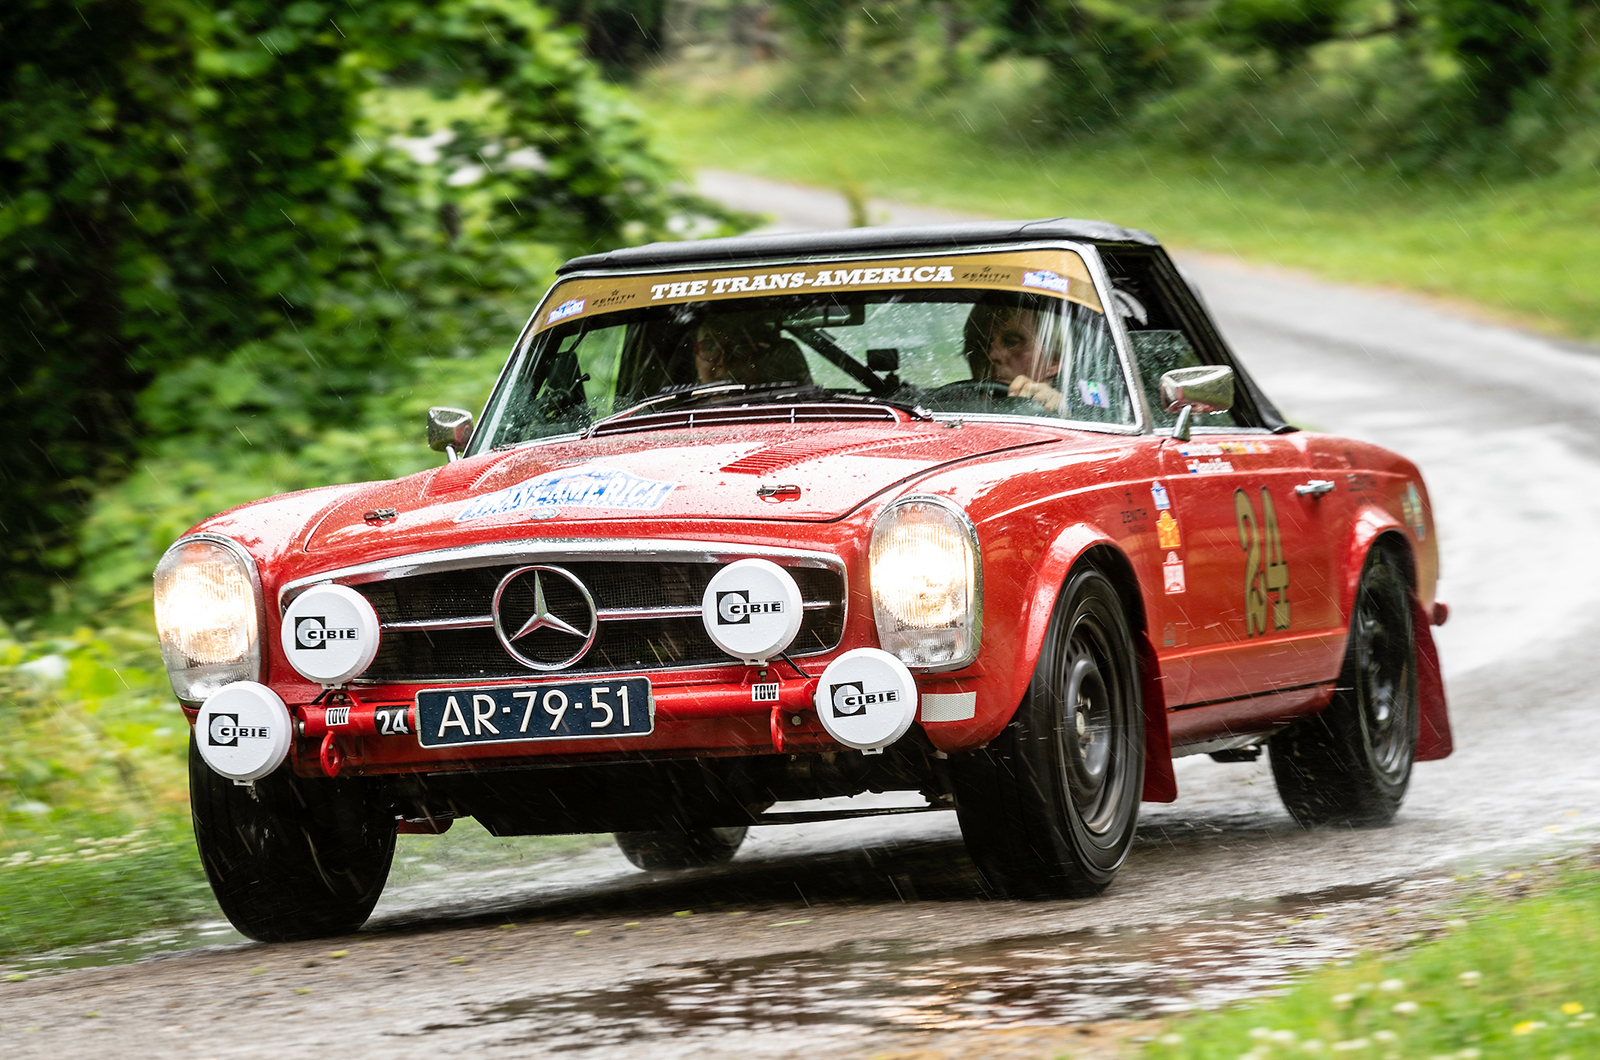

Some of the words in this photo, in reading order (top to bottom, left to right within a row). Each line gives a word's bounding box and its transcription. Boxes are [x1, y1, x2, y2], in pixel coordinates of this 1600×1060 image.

[650, 280, 709, 301] THE
[711, 265, 955, 295] TRANS-AMERICA
[962, 272, 1011, 280] ZENITH
[592, 293, 636, 306] ZENITH
[1234, 485, 1291, 638] 24
[753, 684, 778, 700] TOW
[327, 707, 348, 725] TOW
[376, 709, 408, 735] 24
[437, 685, 630, 738] AR-79-51
